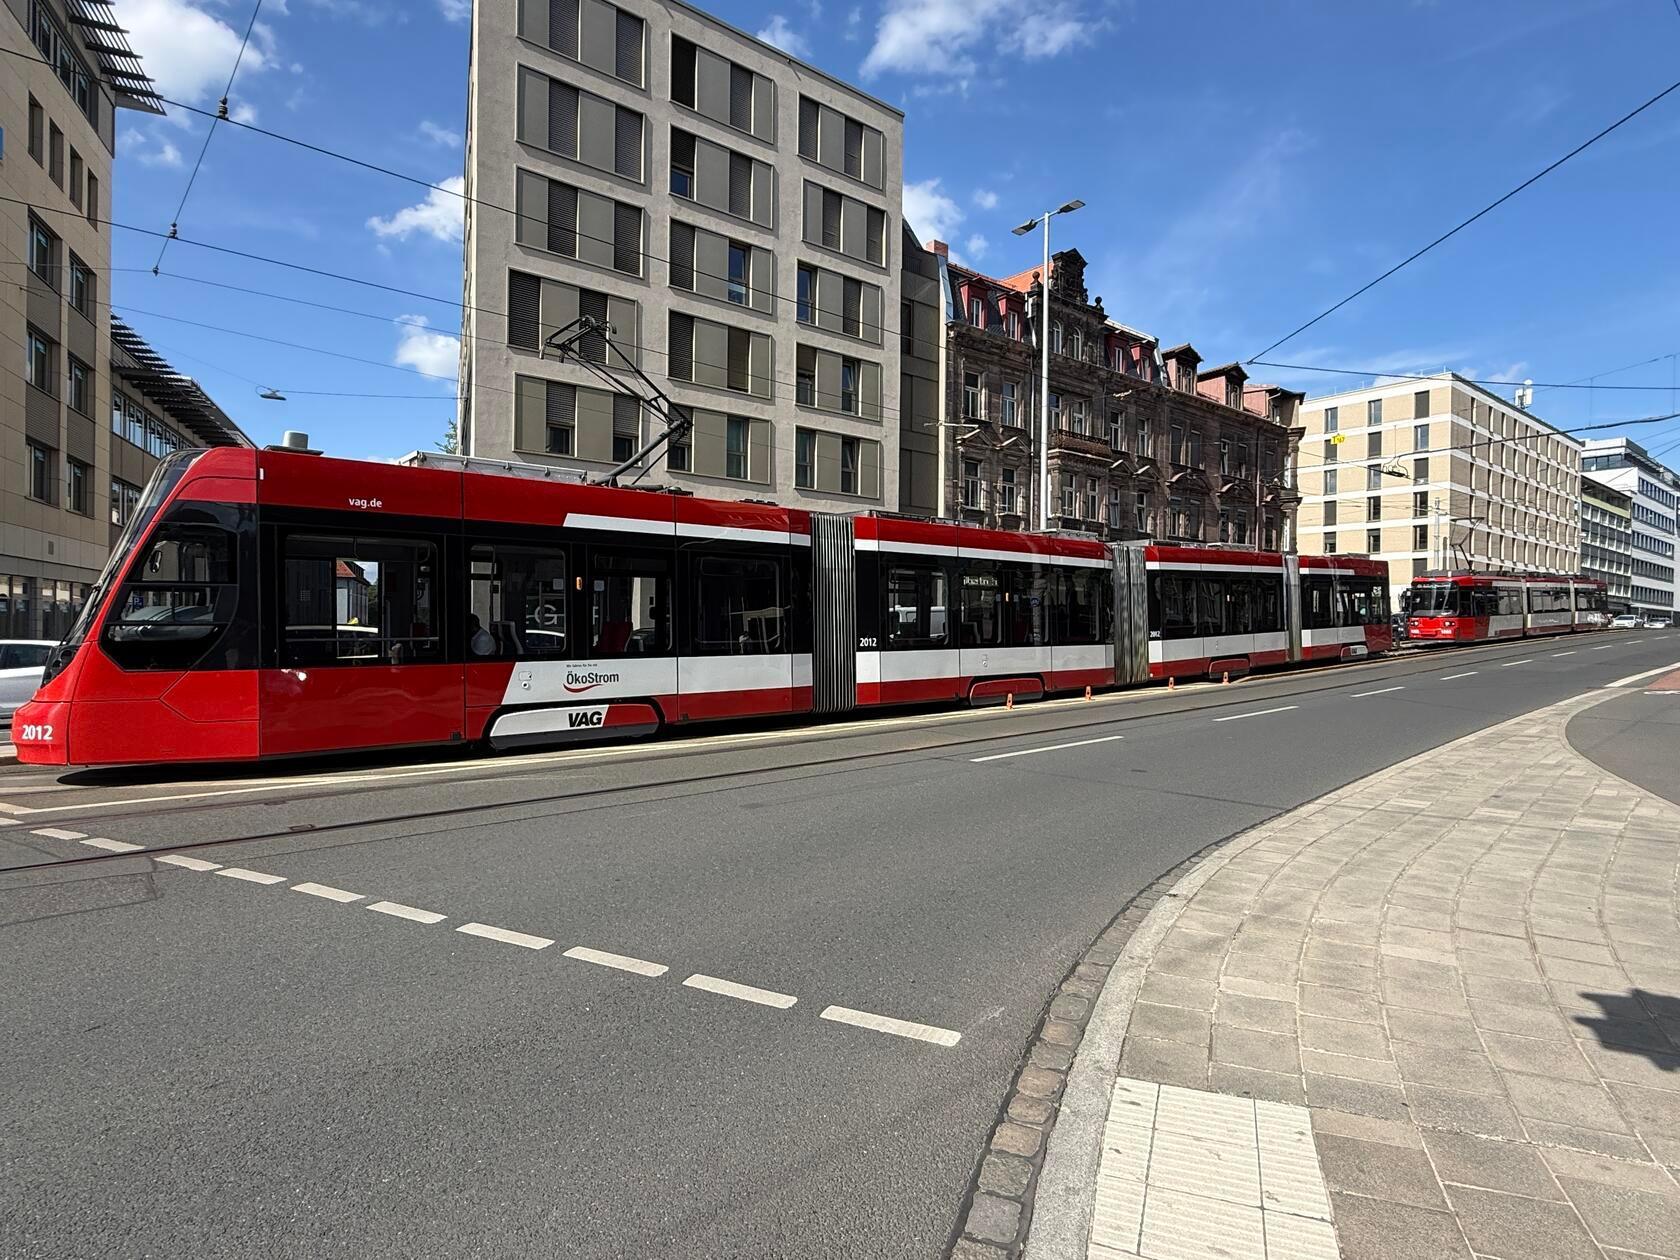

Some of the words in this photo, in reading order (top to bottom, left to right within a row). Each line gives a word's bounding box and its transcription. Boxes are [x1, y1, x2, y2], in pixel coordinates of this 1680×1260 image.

[349, 498, 382, 509] vag.de
[859, 637, 877, 647] 2012
[566, 670, 620, 685] ÖkoStrom
[568, 711, 603, 728] VAG
[22, 724, 53, 740] 2012
